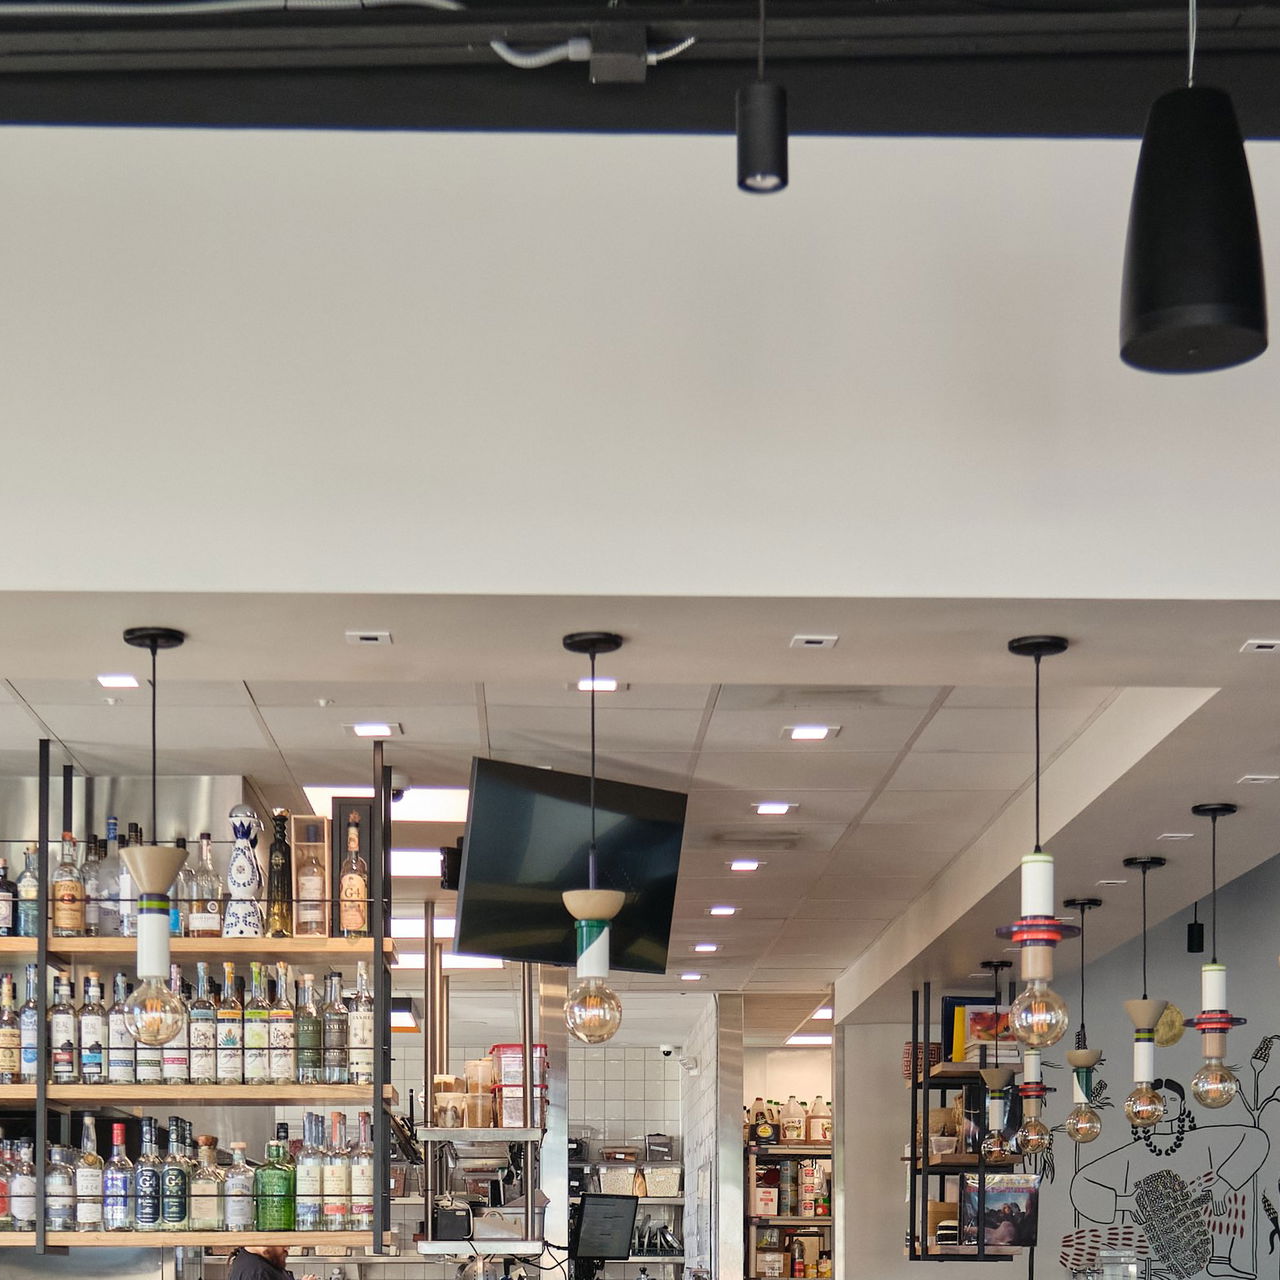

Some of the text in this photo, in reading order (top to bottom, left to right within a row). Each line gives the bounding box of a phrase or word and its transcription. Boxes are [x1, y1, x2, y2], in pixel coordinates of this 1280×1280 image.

[344, 888, 360, 898] G4
[140, 1175, 156, 1187] G4
[166, 1175, 181, 1187] G4
